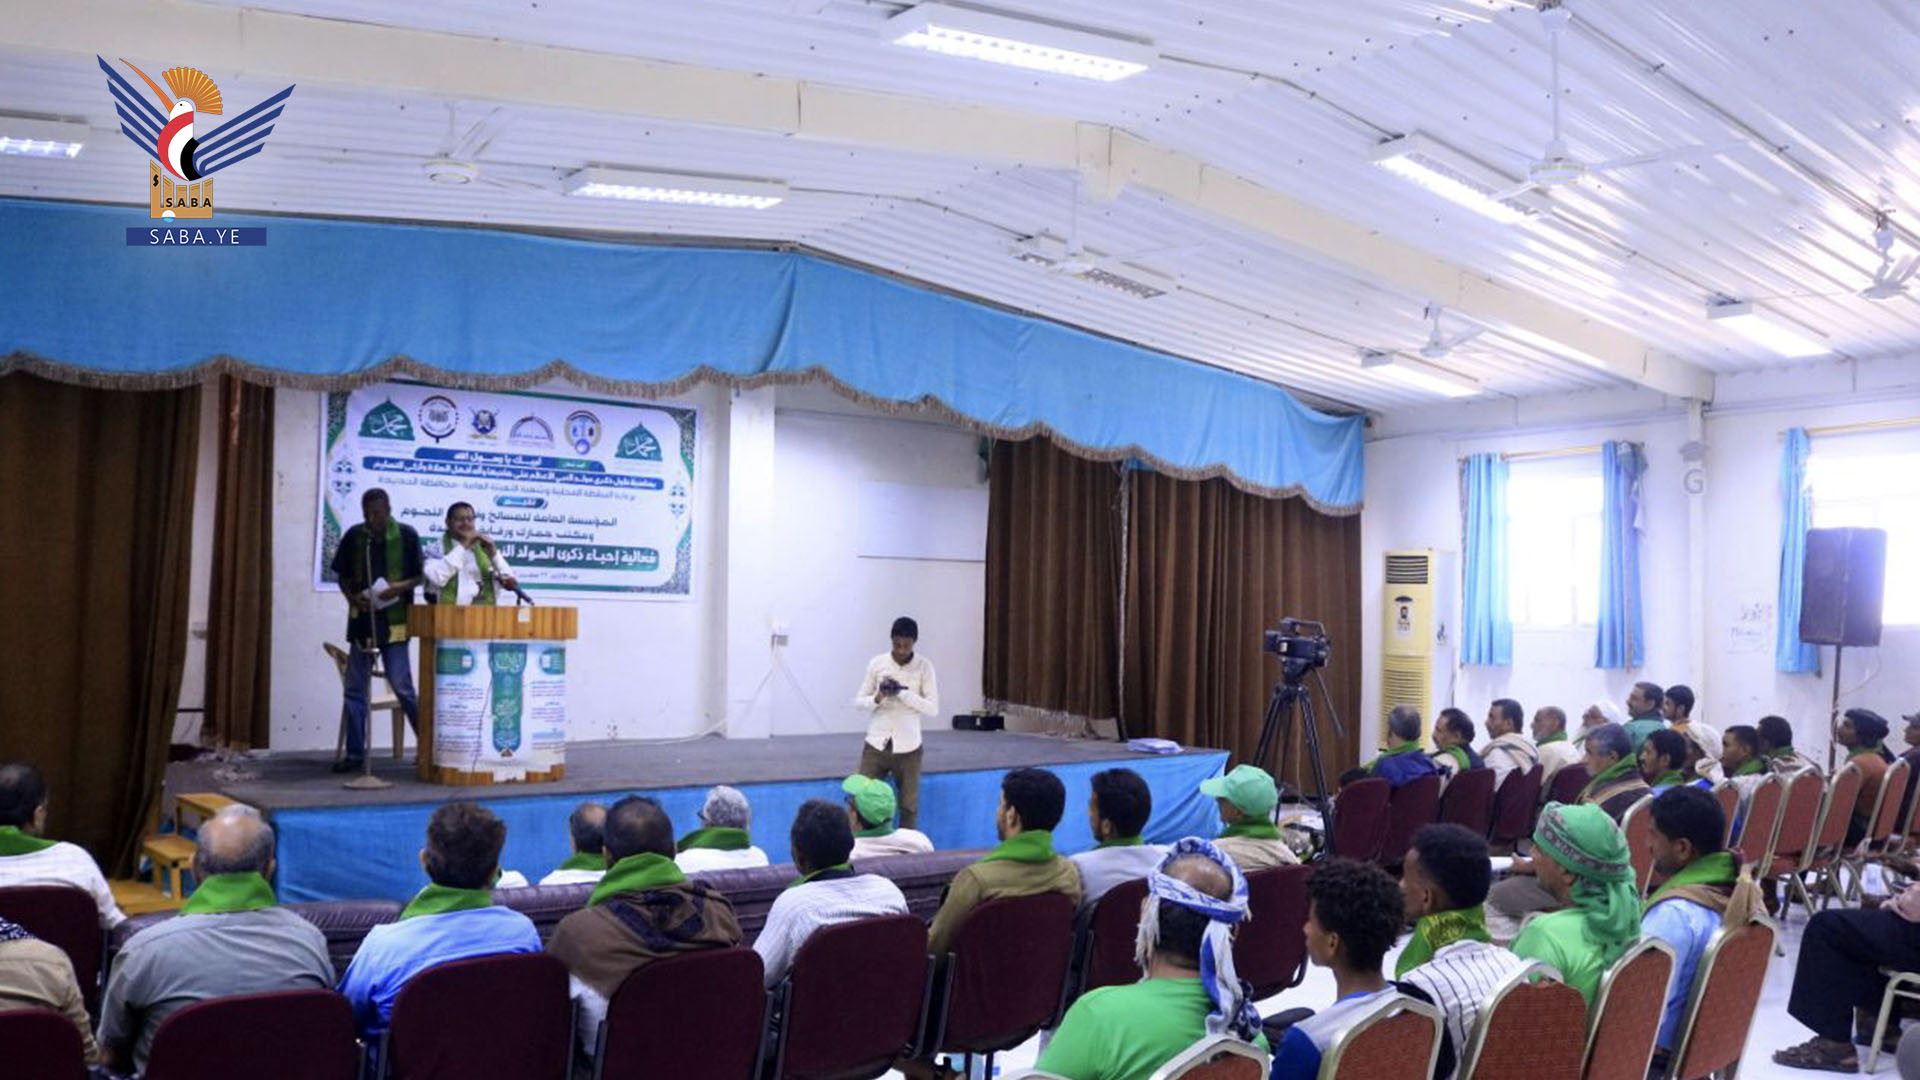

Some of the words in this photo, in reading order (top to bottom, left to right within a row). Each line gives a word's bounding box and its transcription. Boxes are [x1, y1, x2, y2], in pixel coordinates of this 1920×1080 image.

[533, 513, 565, 524] العامة
[567, 515, 617, 528] المؤسسة
[516, 544, 555, 562] المولد
[556, 547, 584, 563] ذكرى
[586, 548, 619, 566] إحياء
[620, 550, 657, 566] فعالية
